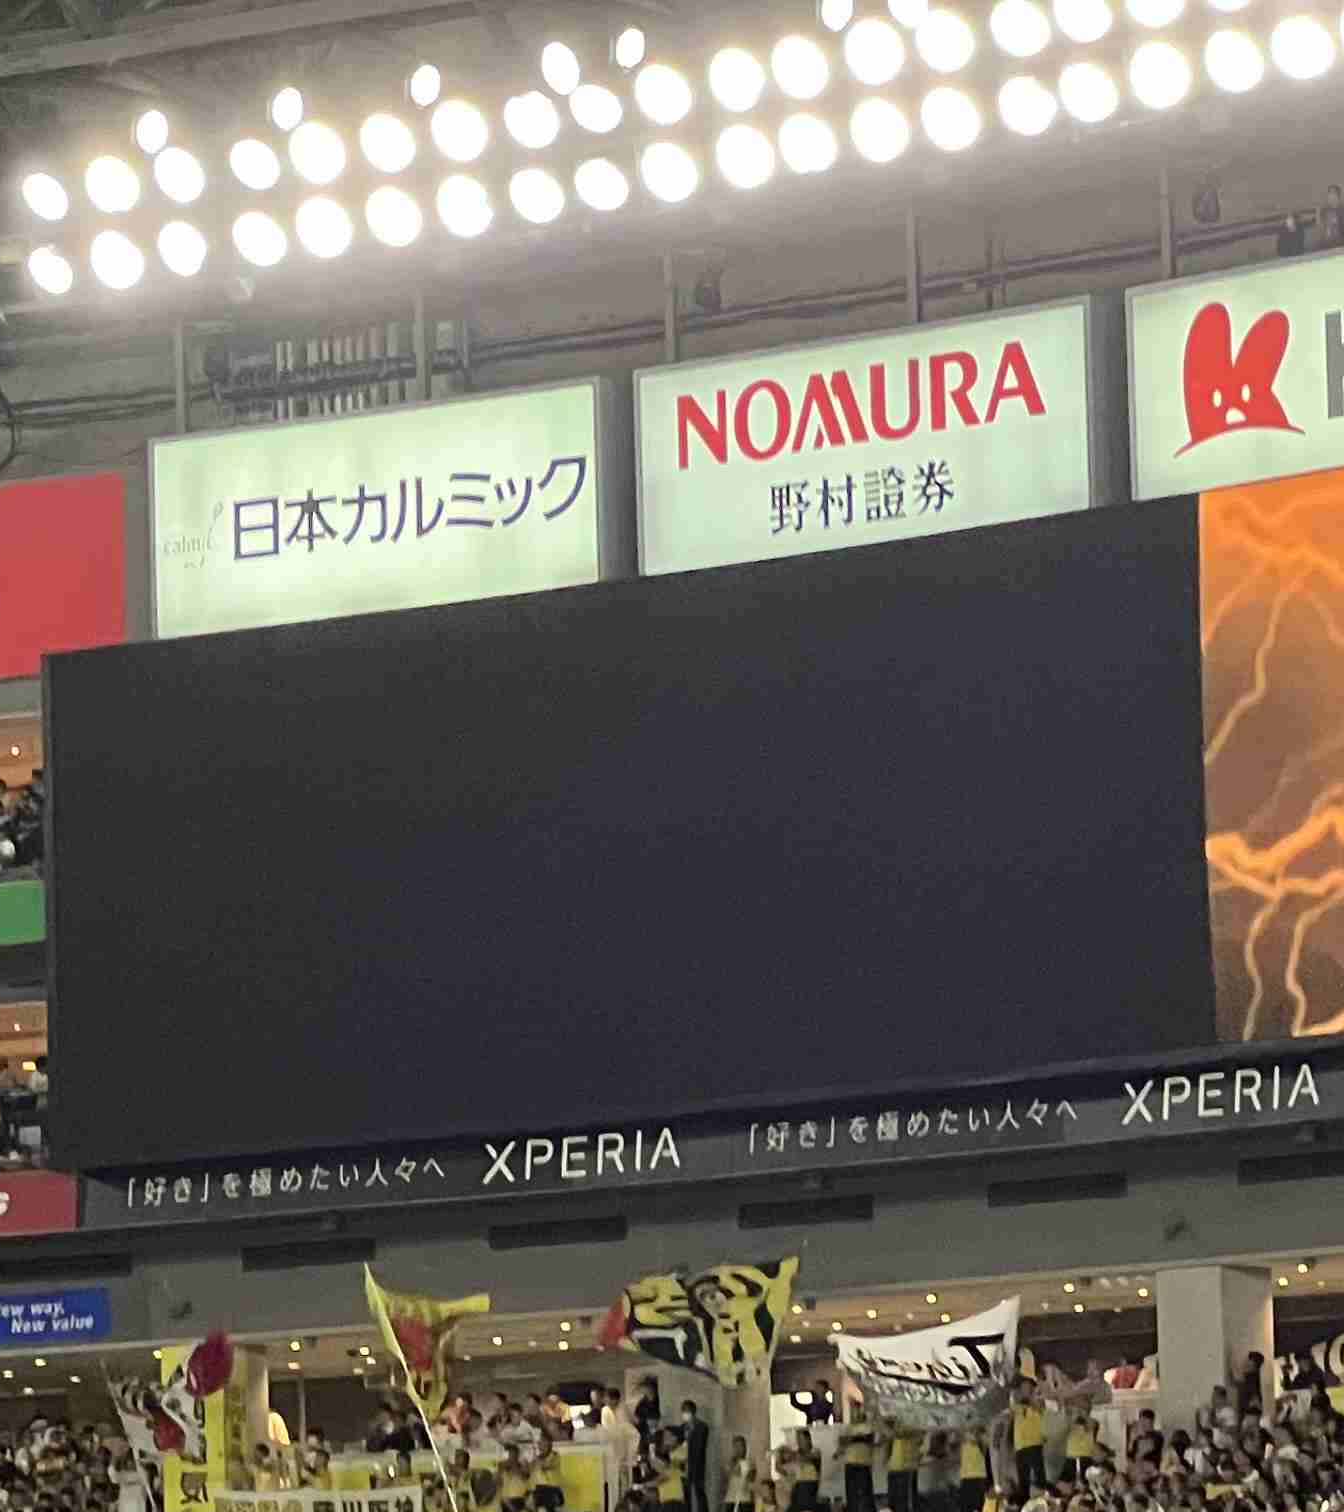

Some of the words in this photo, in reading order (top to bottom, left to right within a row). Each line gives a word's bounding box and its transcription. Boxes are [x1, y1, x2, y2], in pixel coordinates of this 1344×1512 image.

[676, 341, 1047, 470] NOMURA
[232, 455, 588, 563] 日本カルミック
[770, 459, 955, 536] 野村證券
[1121, 1064, 1319, 1125] XPERIA
[482, 1128, 679, 1184] XPERIA
[10, 1316, 48, 1334] New
[52, 1314, 94, 1331] value
